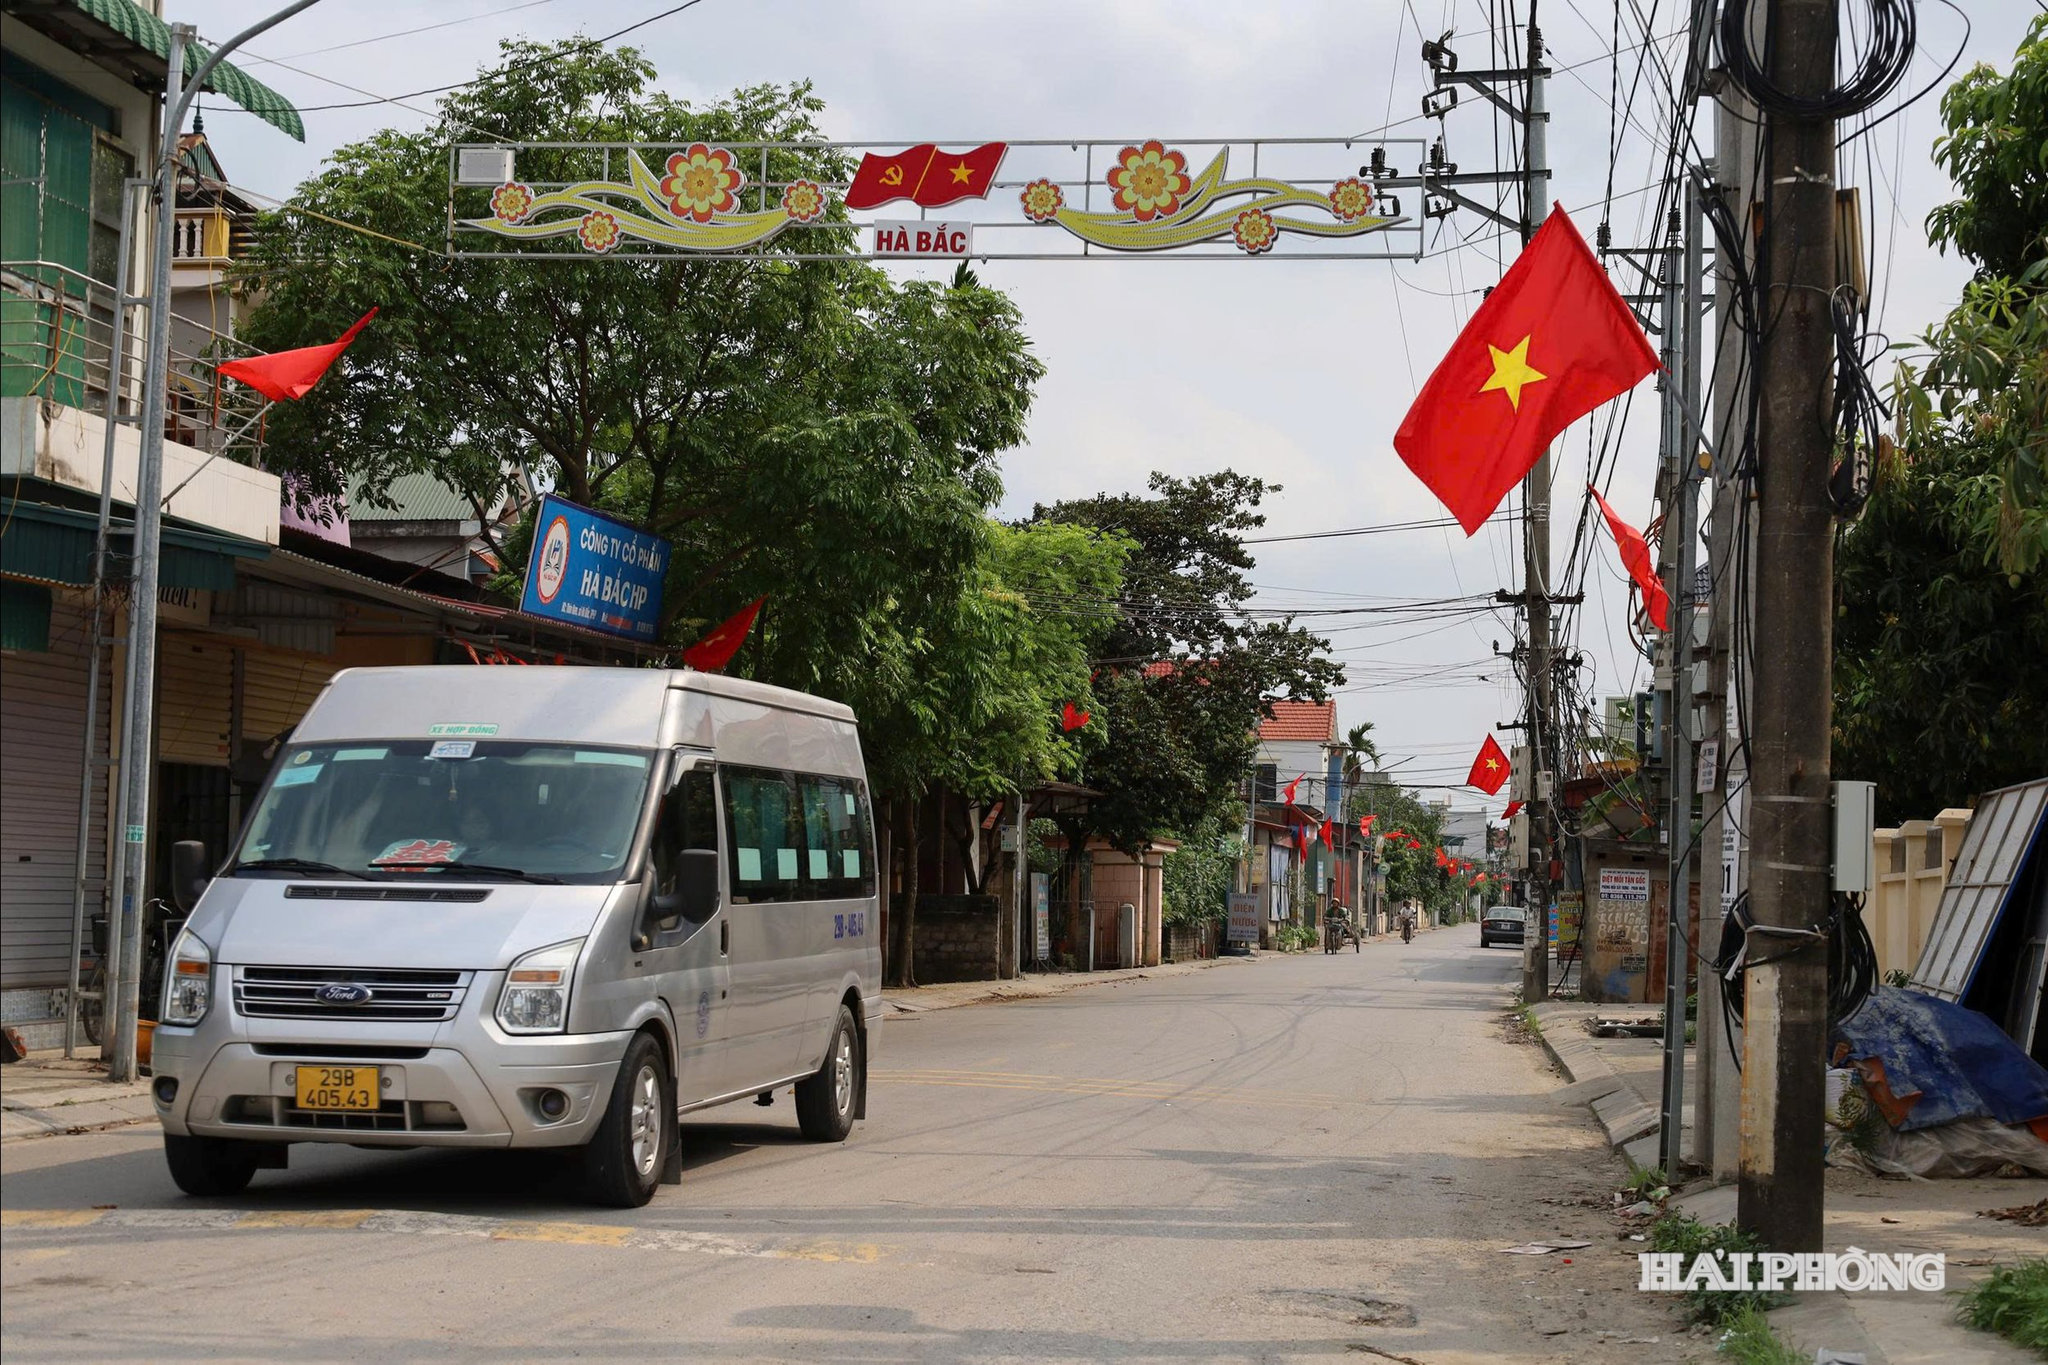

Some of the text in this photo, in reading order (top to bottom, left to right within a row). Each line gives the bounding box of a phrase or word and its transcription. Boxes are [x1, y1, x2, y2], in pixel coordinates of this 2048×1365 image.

[876, 223, 966, 253] HÀ BẮC
[580, 524, 662, 573] CÔNG TY CỔ PHẦN
[580, 564, 600, 599] HÀ
[629, 584, 648, 610] HP
[430, 726, 444, 734] XE
[325, 985, 359, 1001] Ford
[319, 1069, 355, 1087] 29B
[306, 1089, 370, 1108] 405.43
